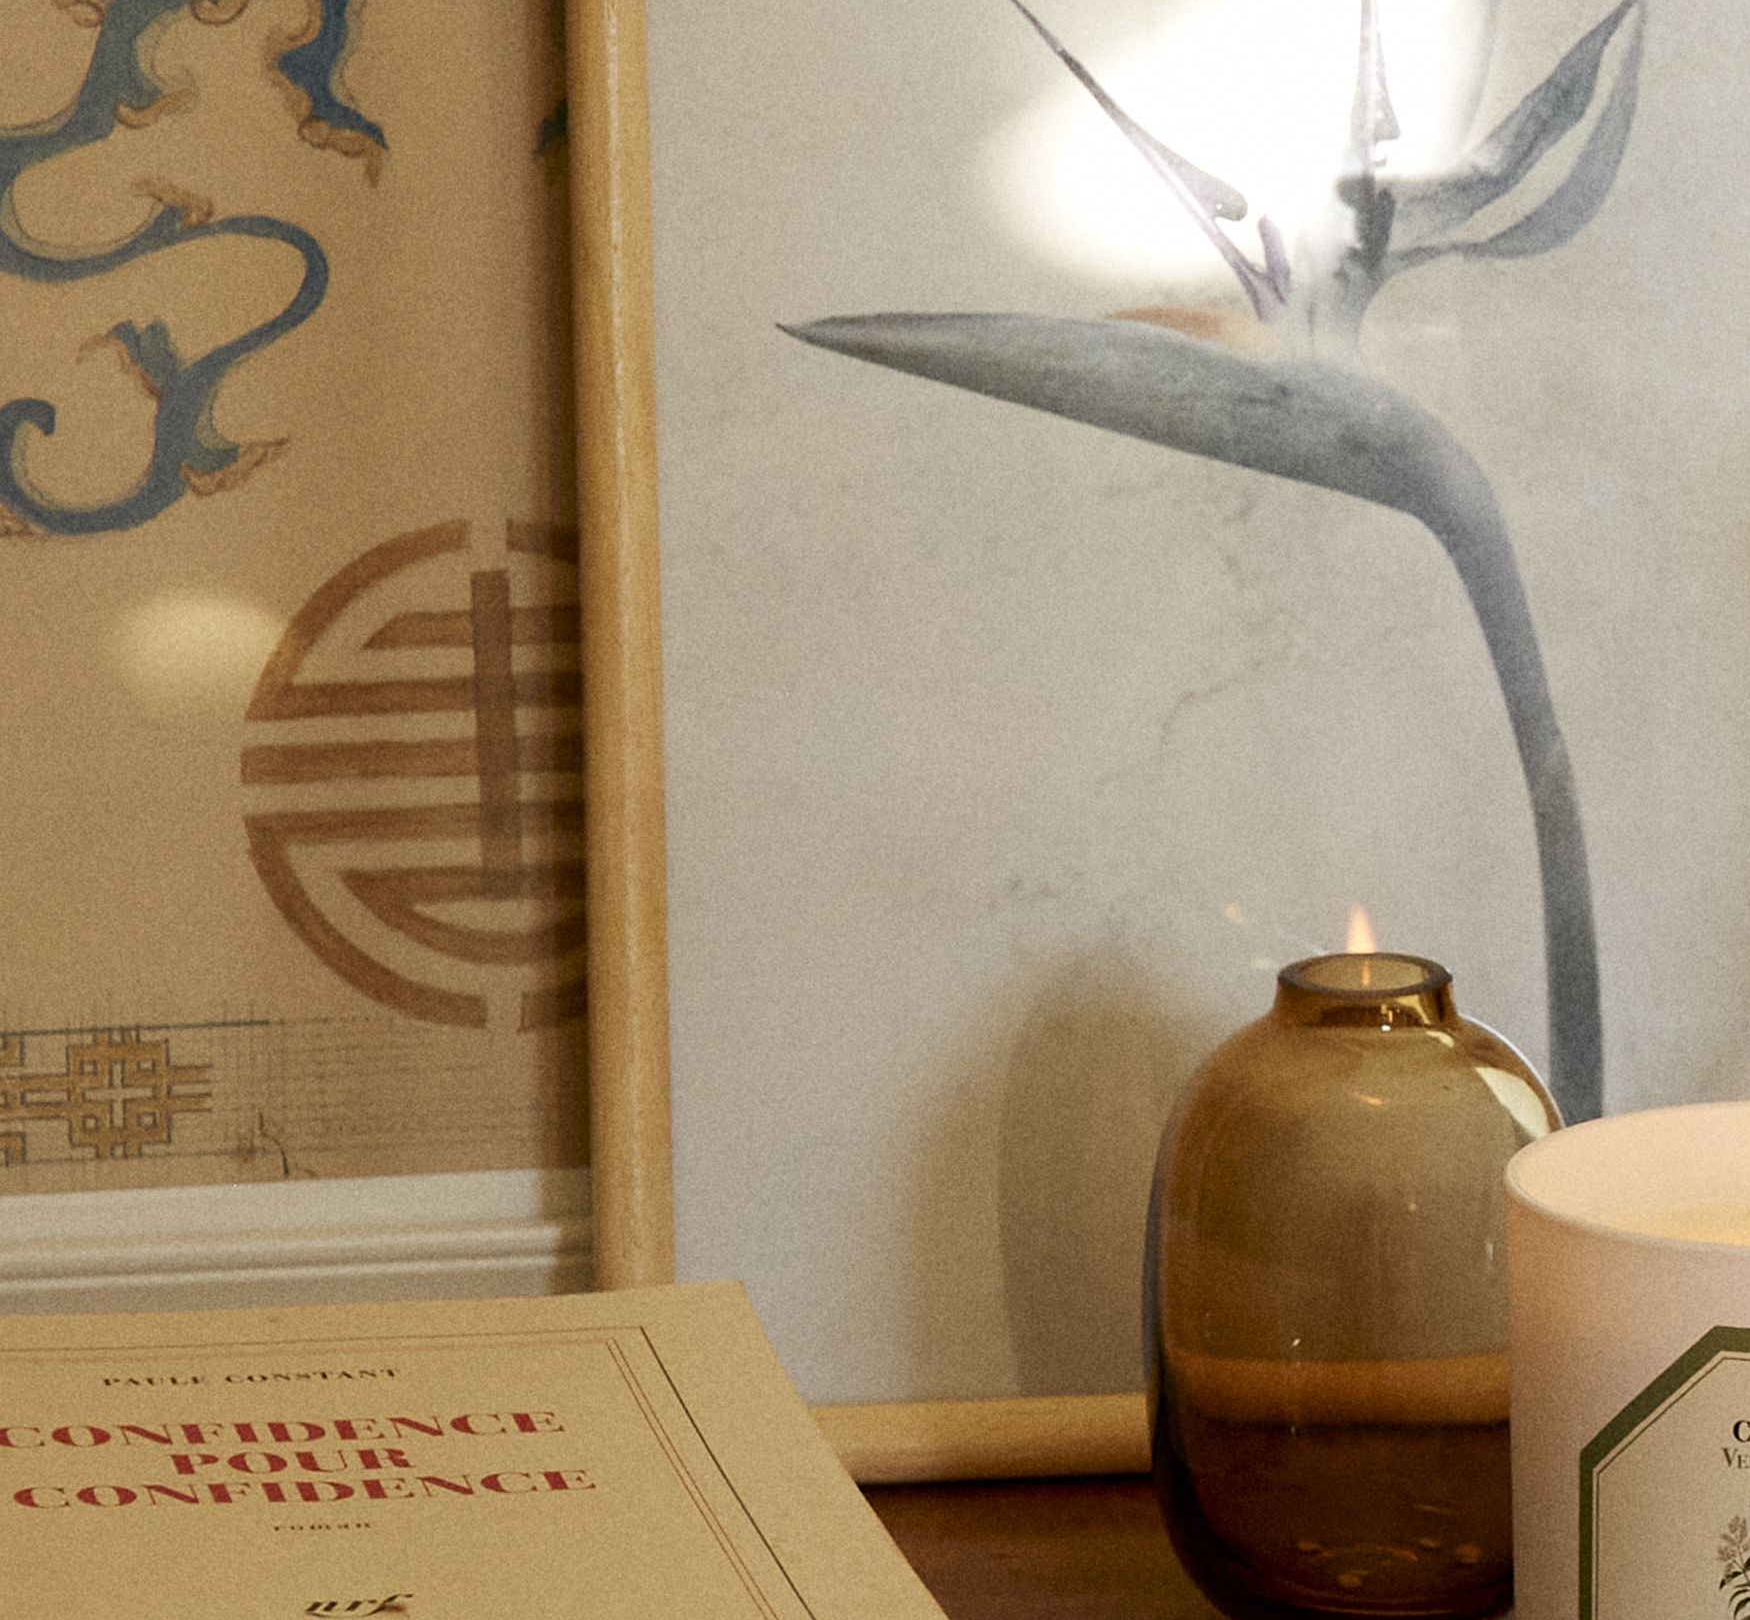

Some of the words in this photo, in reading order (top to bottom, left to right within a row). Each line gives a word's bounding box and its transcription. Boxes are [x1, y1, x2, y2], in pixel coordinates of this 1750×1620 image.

[103, 1375, 206, 1387] PAULE
[224, 1368, 399, 1385] CONSTANT
[0, 1411, 566, 1450] CONFIDENCE
[168, 1447, 418, 1476] POUR
[13, 1469, 597, 1509] CONFIDENCE
[304, 1593, 414, 1619] nrf
